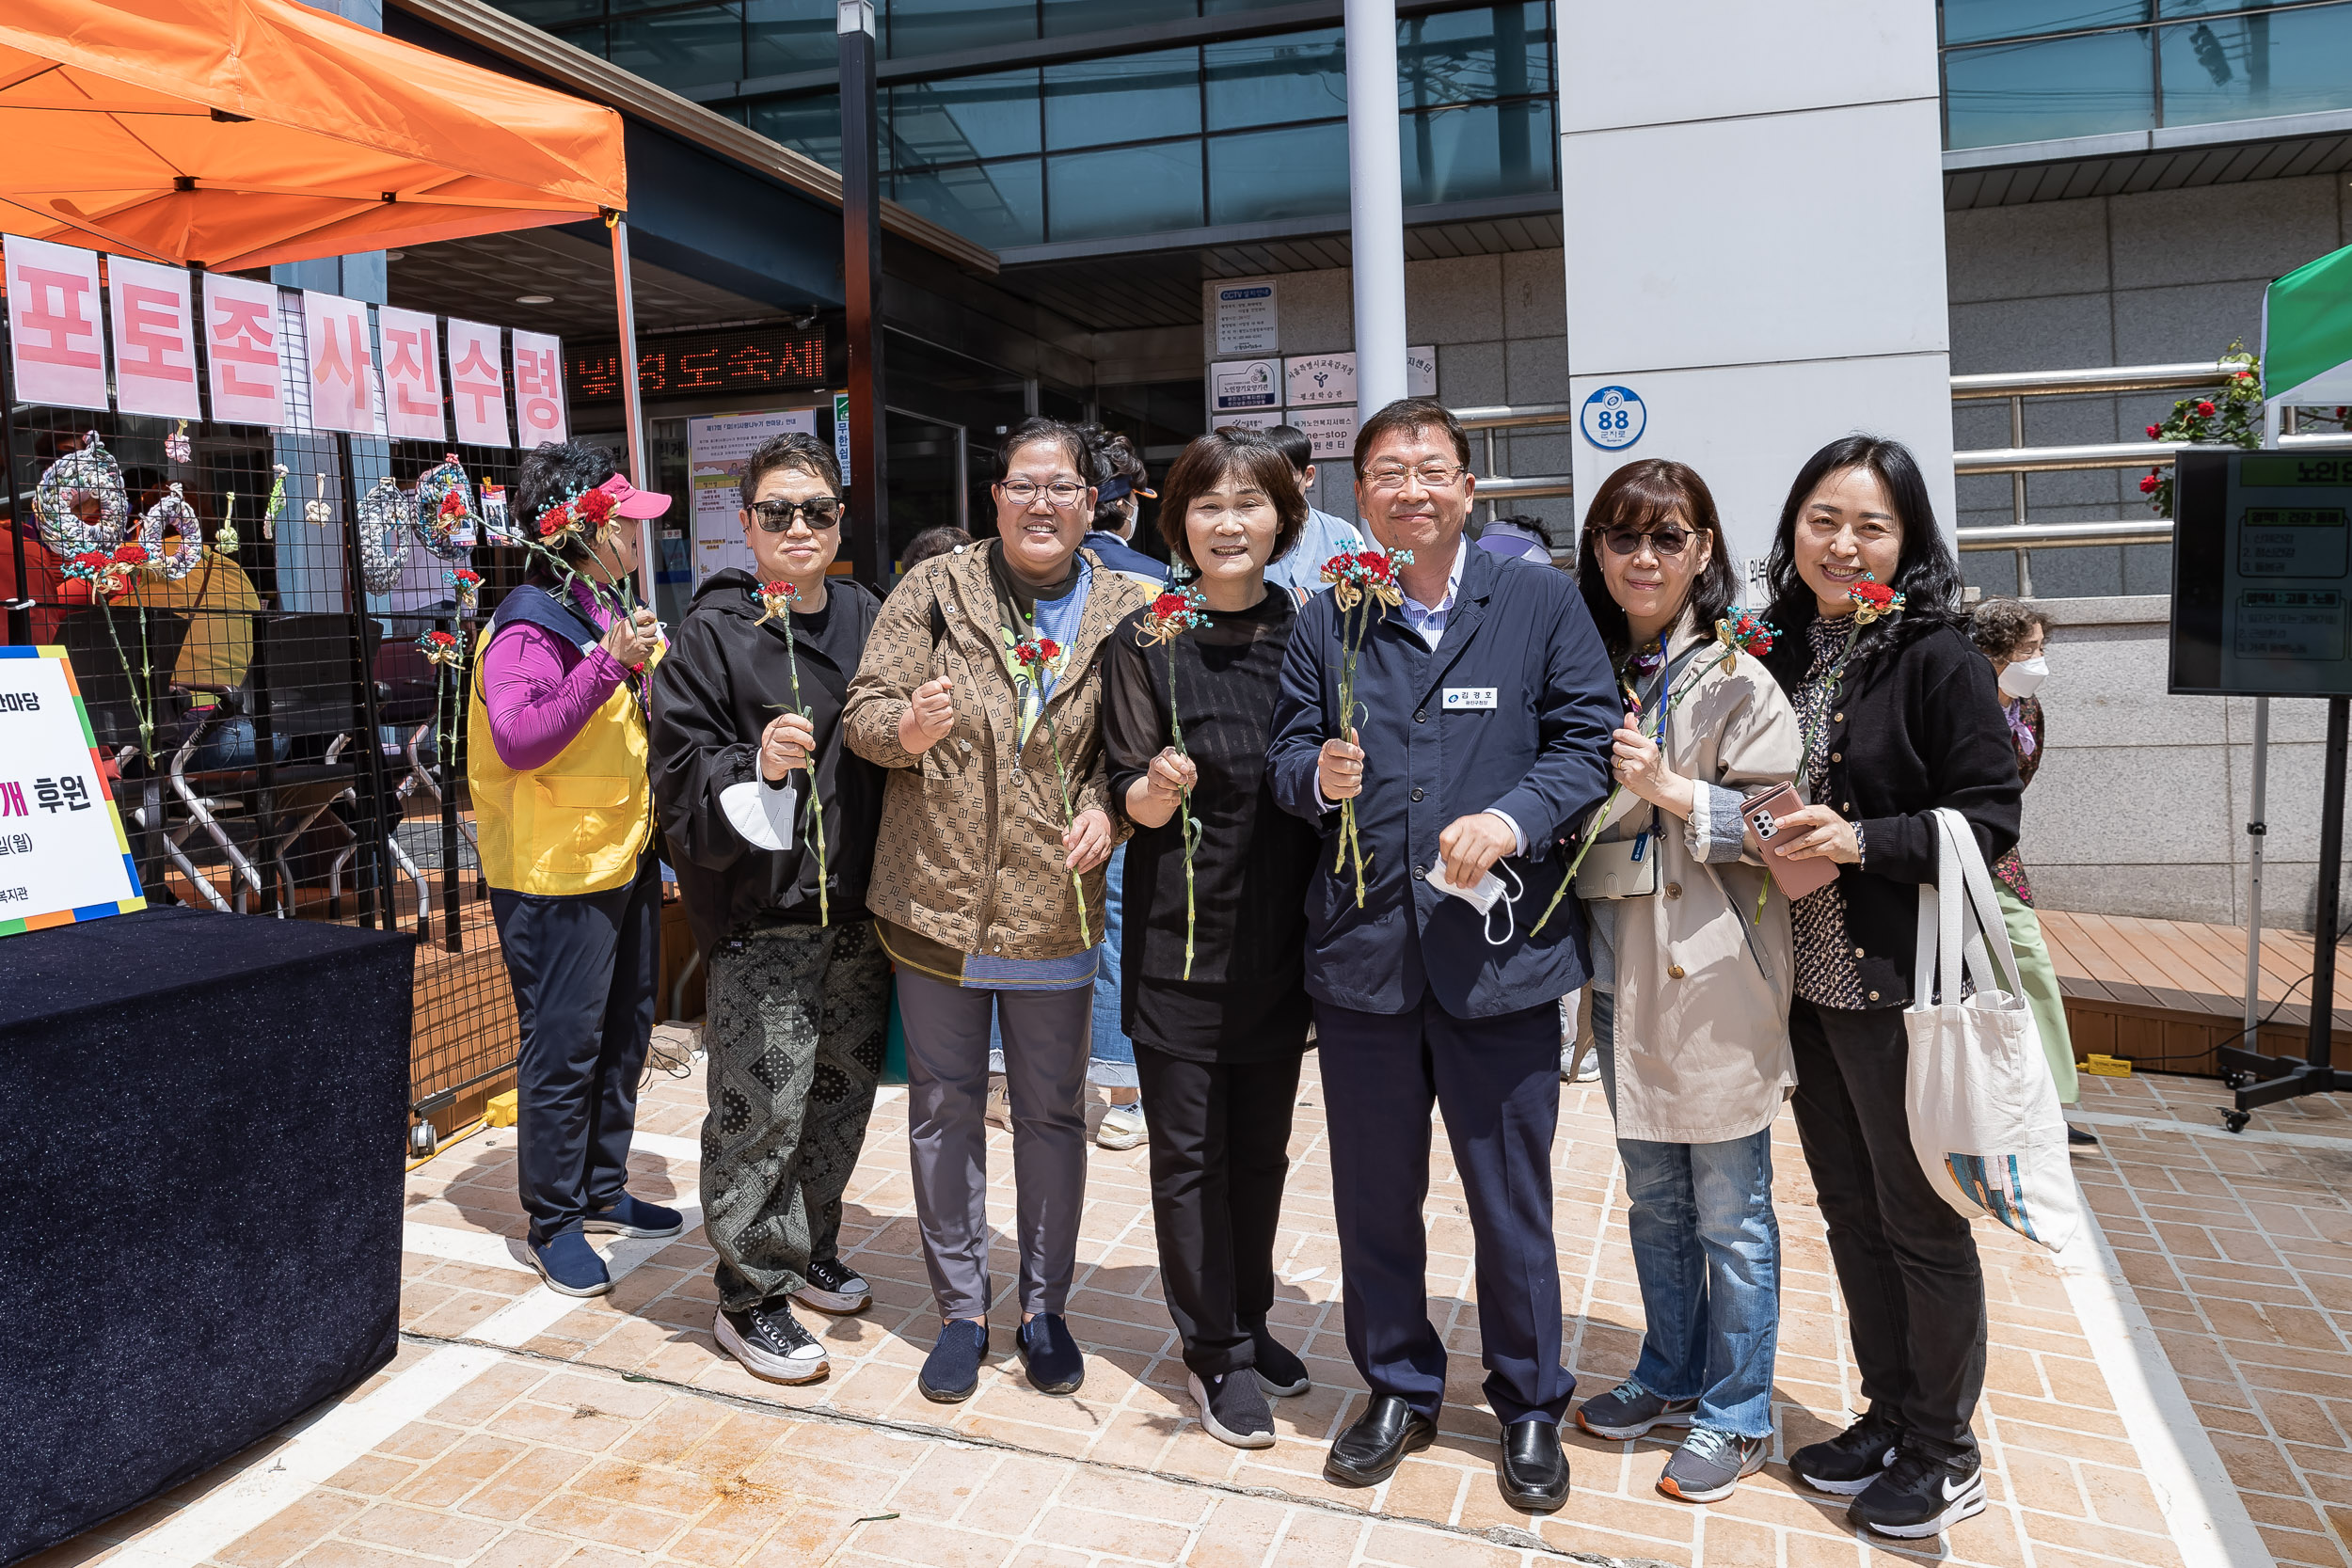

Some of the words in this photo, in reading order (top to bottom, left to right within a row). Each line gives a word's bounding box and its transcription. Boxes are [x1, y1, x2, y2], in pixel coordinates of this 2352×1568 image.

[1223, 291, 1242, 300] CCTV
[1224, 384, 1268, 393] 노인장기요양기관
[1300, 389, 1343, 401] 평생학습관
[1598, 410, 1629, 430] 88
[1306, 430, 1348, 439] ne-stop
[1313, 440, 1345, 451] 원센터
[2297, 462, 2339, 483] 노인
[33, 775, 91, 814] 후원
